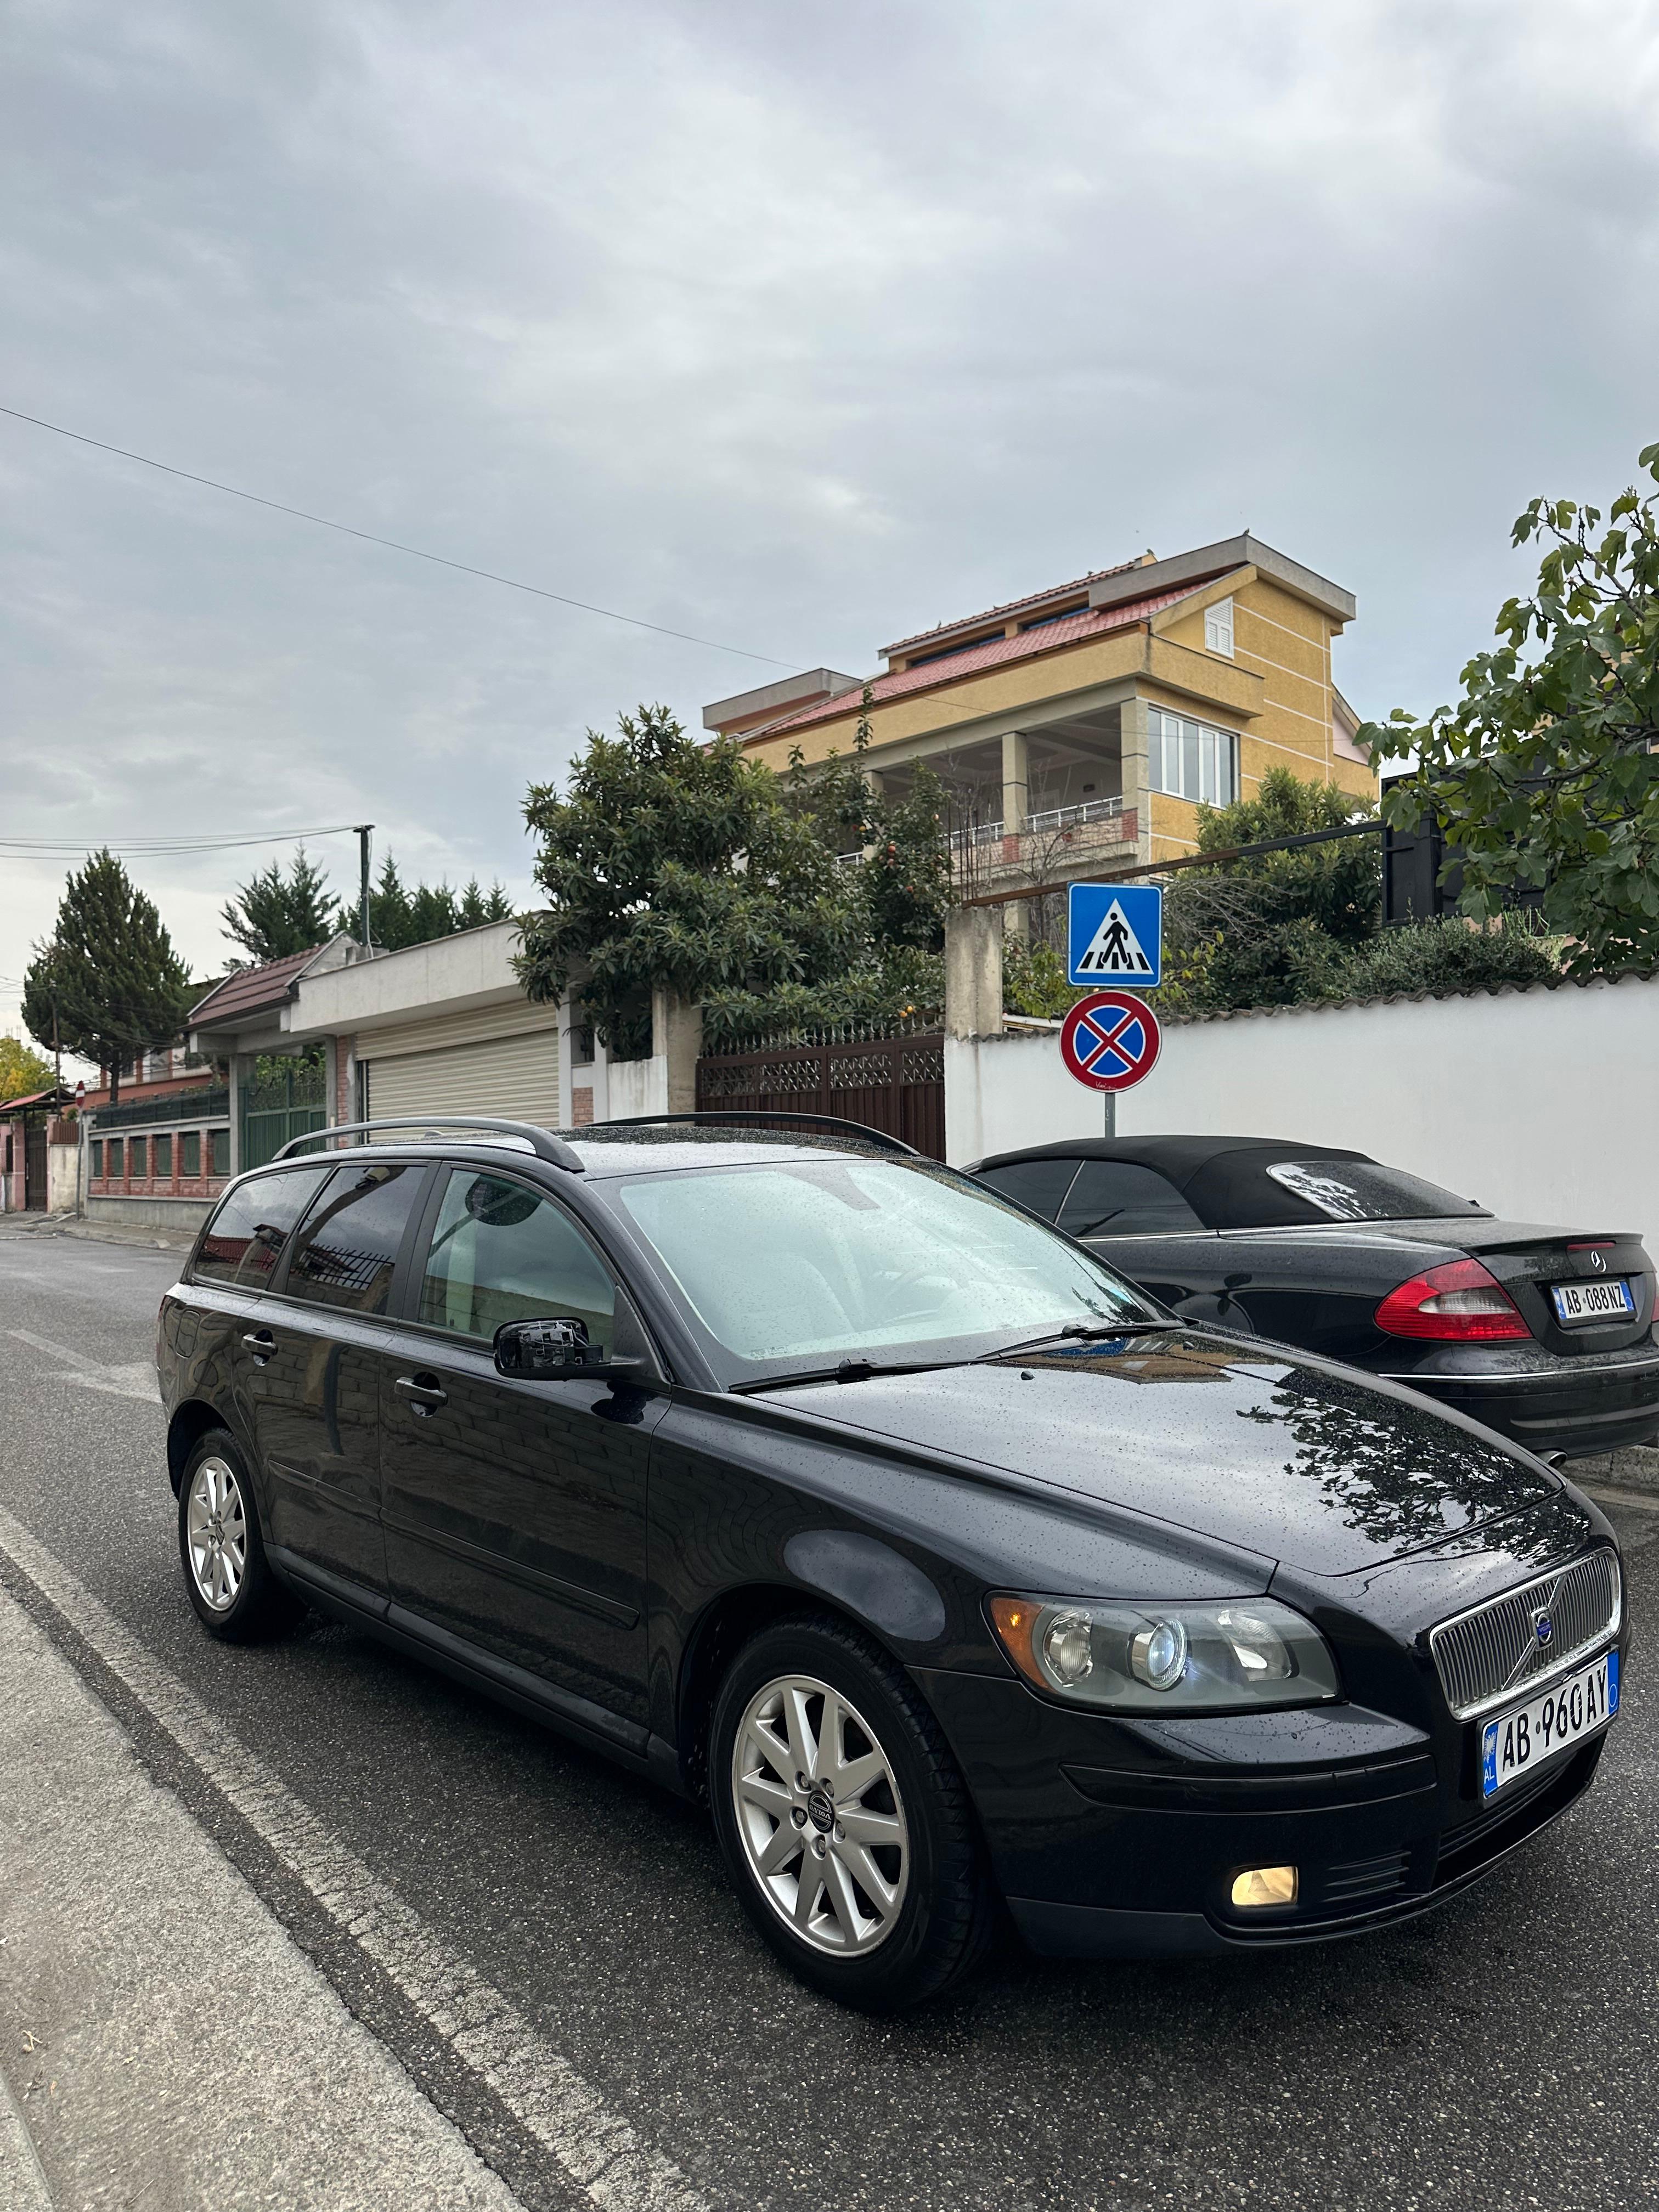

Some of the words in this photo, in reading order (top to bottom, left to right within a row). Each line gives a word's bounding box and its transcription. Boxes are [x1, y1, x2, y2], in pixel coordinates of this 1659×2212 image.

[1565, 1289, 1582, 1314] AB
[1502, 1712, 1531, 1772] AB
[1483, 1765, 1495, 1784] AL
[809, 1804, 832, 1820] VOLVO
